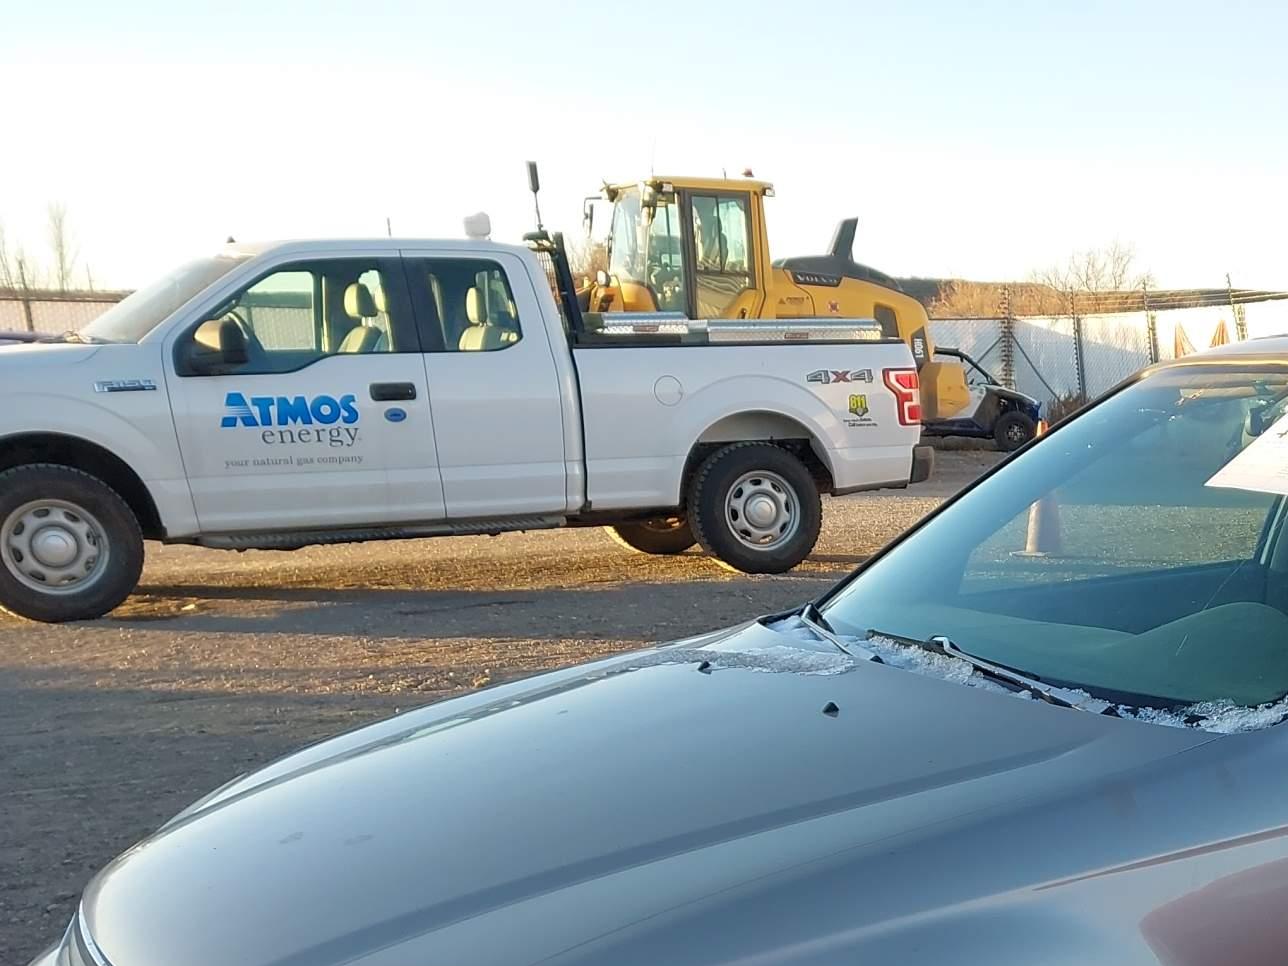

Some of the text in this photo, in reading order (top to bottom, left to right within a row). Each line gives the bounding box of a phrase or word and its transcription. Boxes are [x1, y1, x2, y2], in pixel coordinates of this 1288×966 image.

[220, 392, 359, 428] ATMOS
[848, 394, 867, 409] 811
[261, 427, 359, 447] energy
[224, 455, 364, 469] your natural gas company
